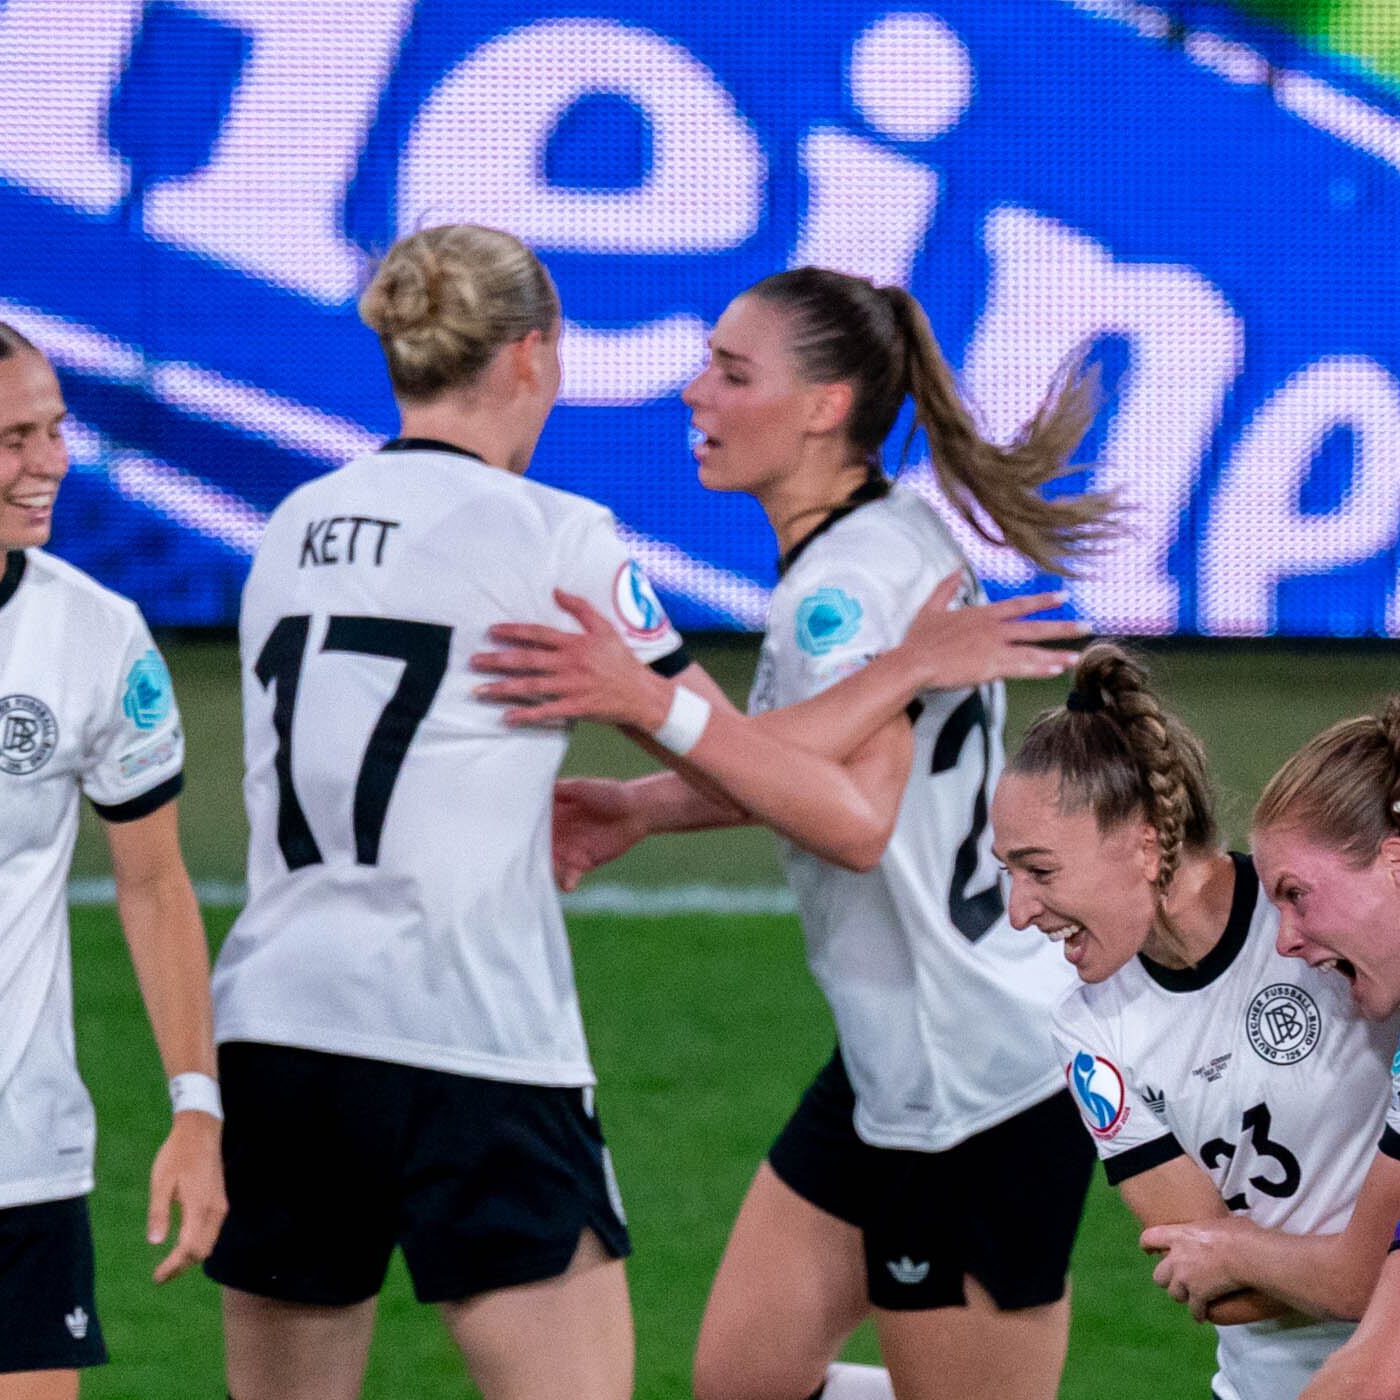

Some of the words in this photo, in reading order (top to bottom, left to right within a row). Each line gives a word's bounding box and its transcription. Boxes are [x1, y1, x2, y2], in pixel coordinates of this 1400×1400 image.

[299, 515, 400, 568] KETT
[254, 614, 455, 872] 17
[1200, 1101, 1303, 1212] 23
